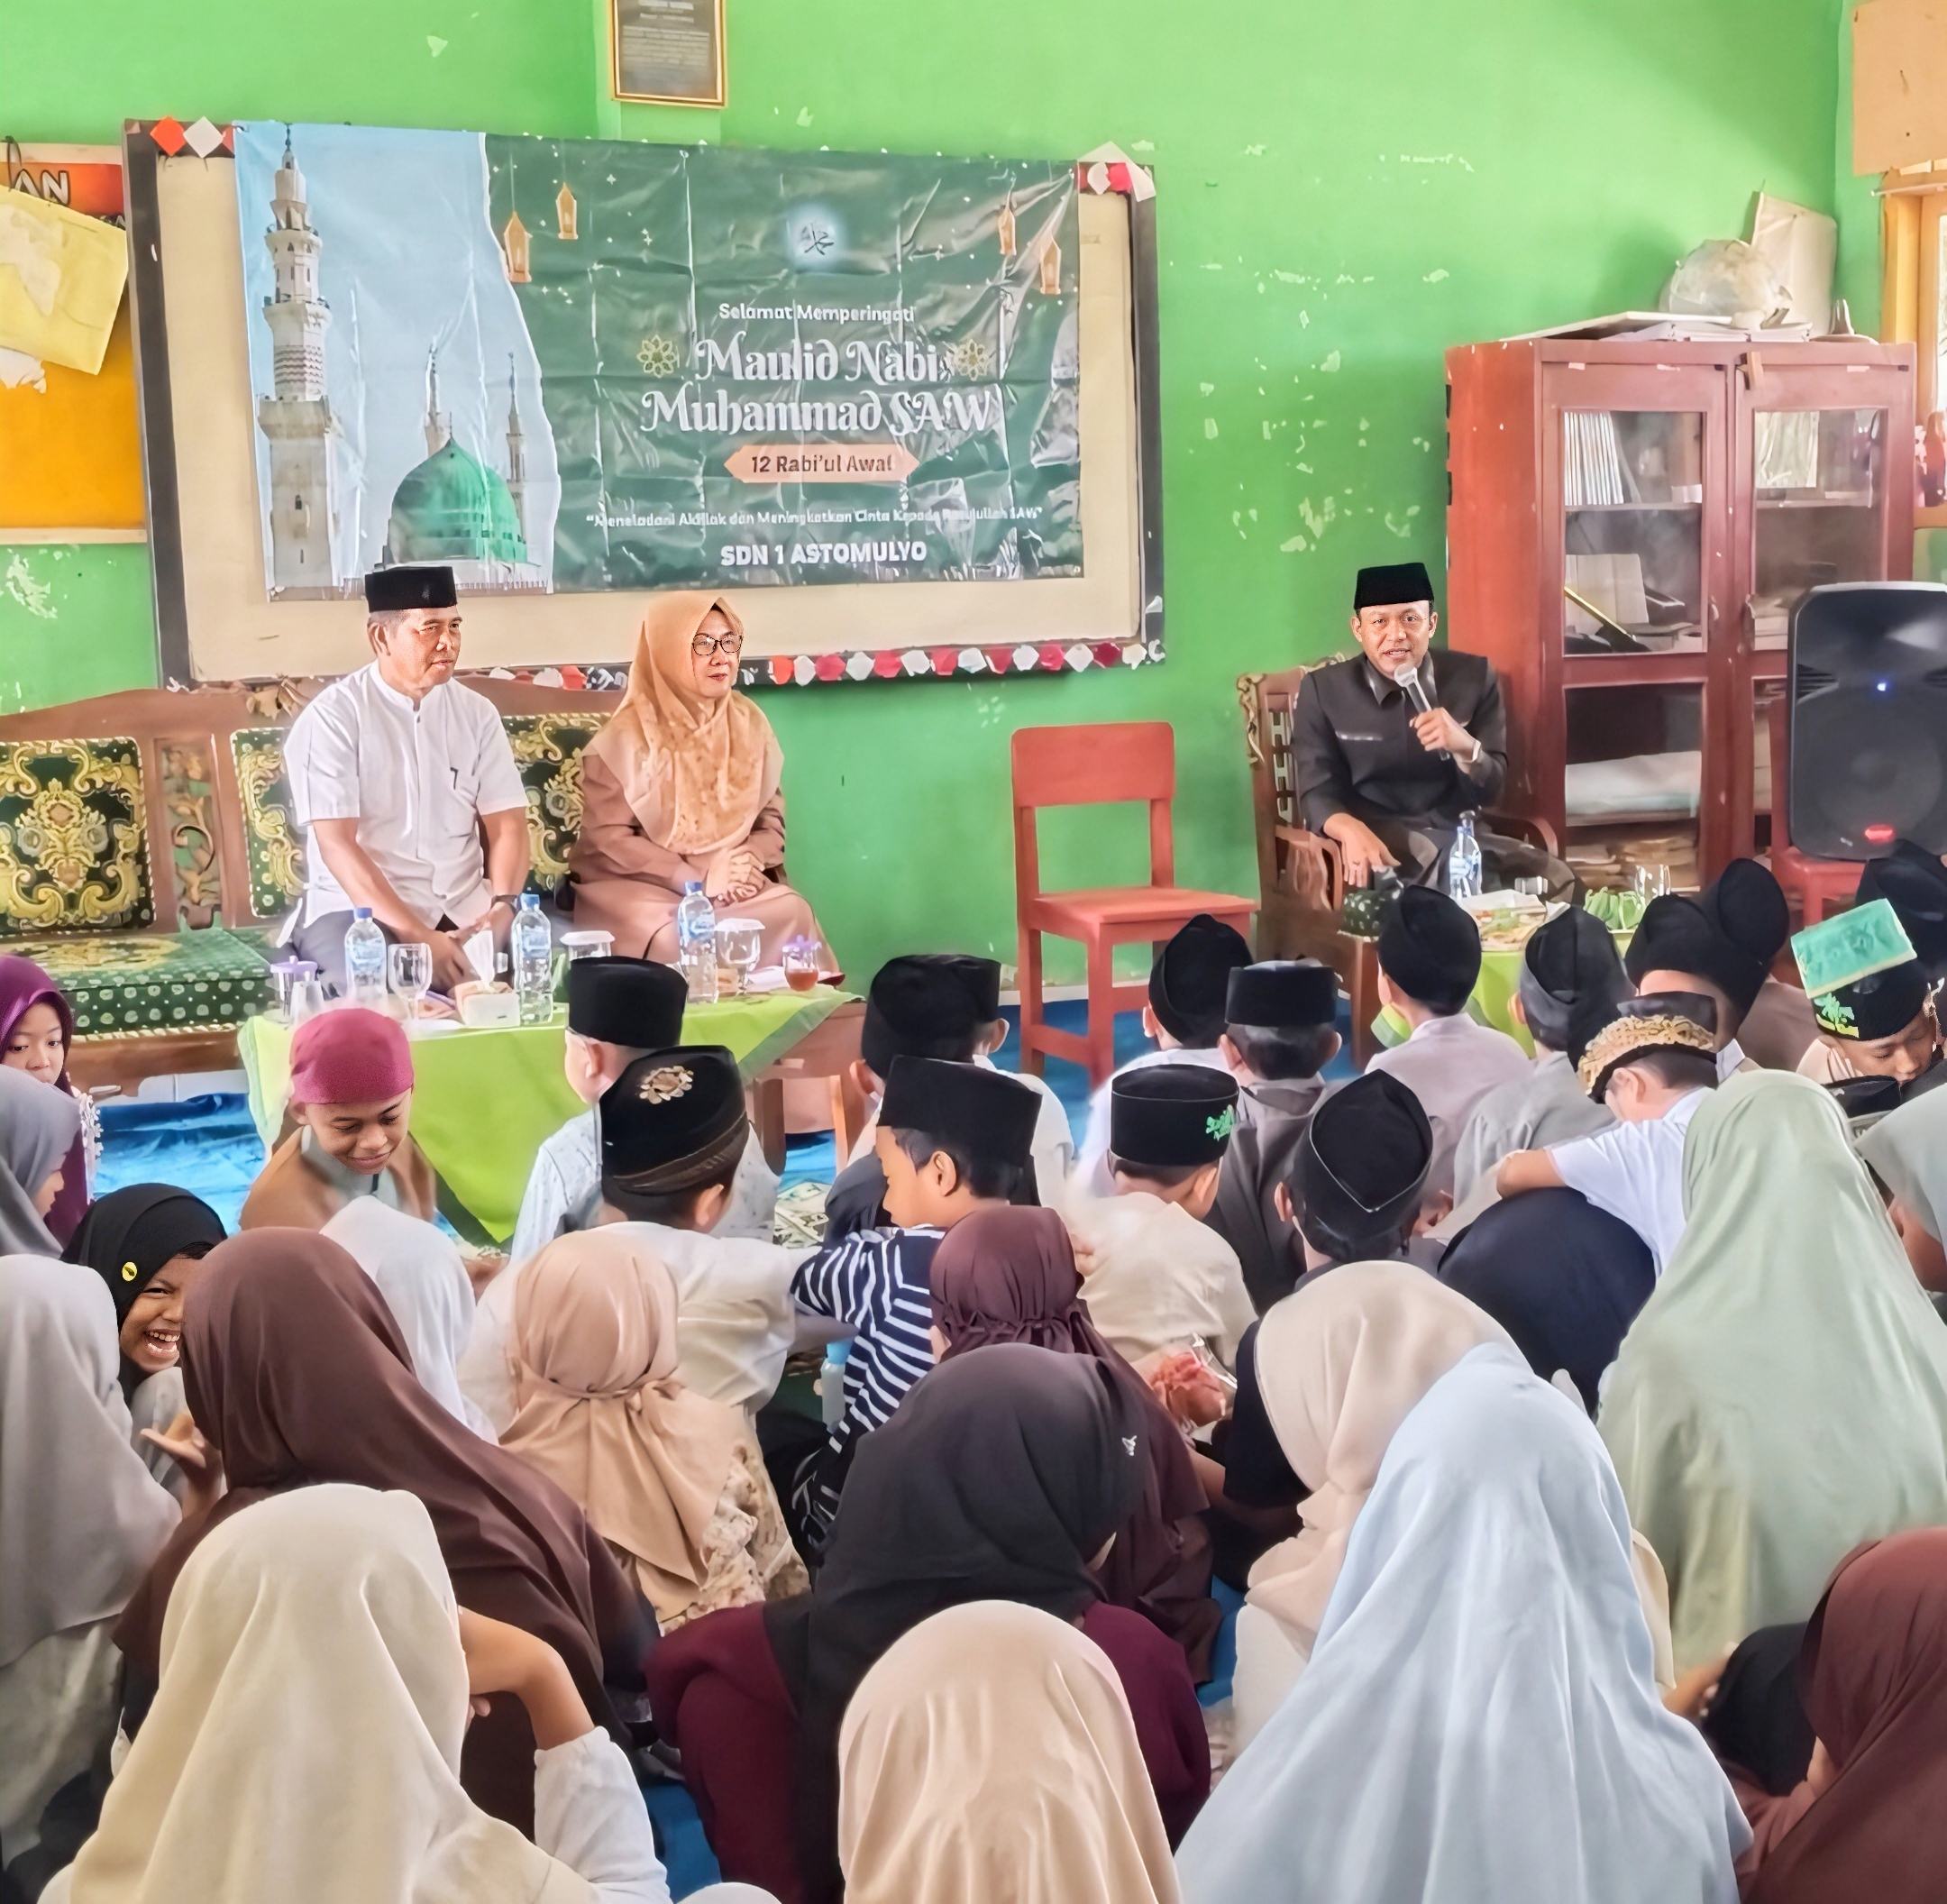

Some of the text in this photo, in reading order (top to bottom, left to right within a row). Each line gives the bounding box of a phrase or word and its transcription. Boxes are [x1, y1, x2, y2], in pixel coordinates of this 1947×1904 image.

[719, 303, 914, 324] Selamat Memperingati
[697, 330, 937, 385] Maulid Nabi
[640, 382, 991, 436] Muhammad SAW
[752, 454, 891, 472] 12 Rabi'ul Awal
[729, 512, 754, 525] dan
[757, 511, 852, 526] Meningkatkan
[721, 542, 928, 566] SDN 1 ASTOMULYO
